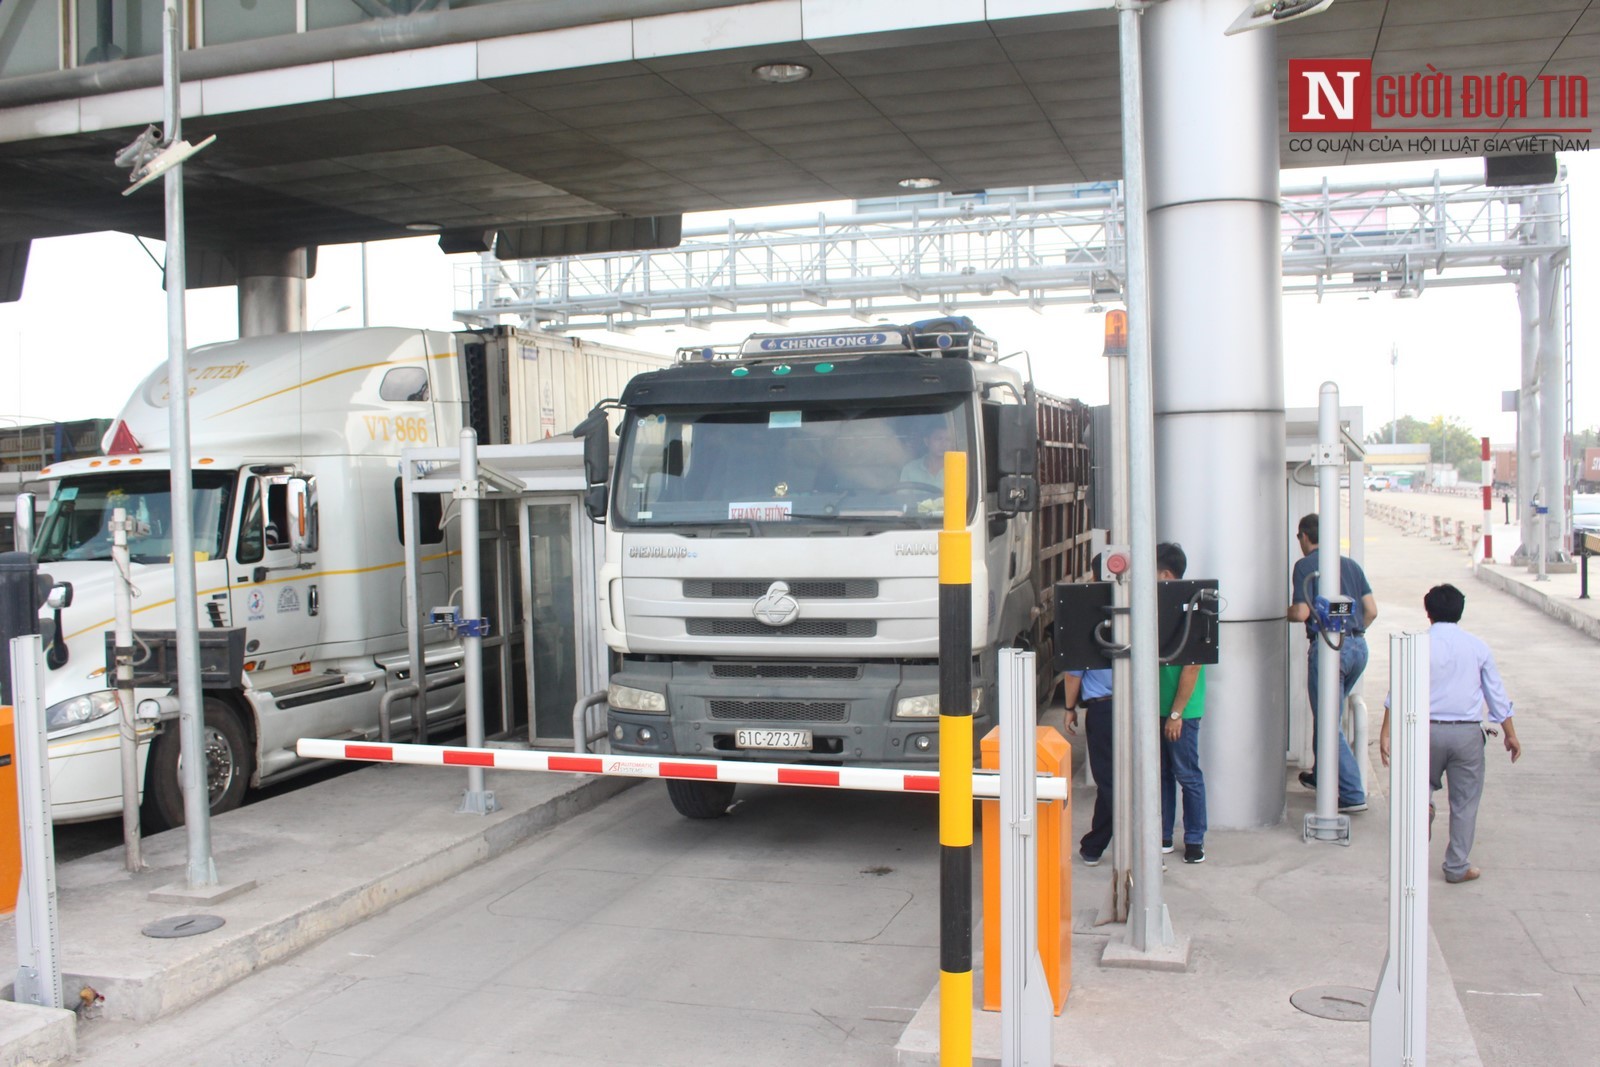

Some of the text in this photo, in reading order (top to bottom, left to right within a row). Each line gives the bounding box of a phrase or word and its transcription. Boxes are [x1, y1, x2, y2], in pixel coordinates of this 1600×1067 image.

[780, 336, 867, 350] CHENGLONG
[362, 415, 429, 444] VT 866
[731, 507, 762, 521] KHANG
[629, 545, 687, 559] CHENGLONG
[738, 731, 809, 747] 61C-273.74
